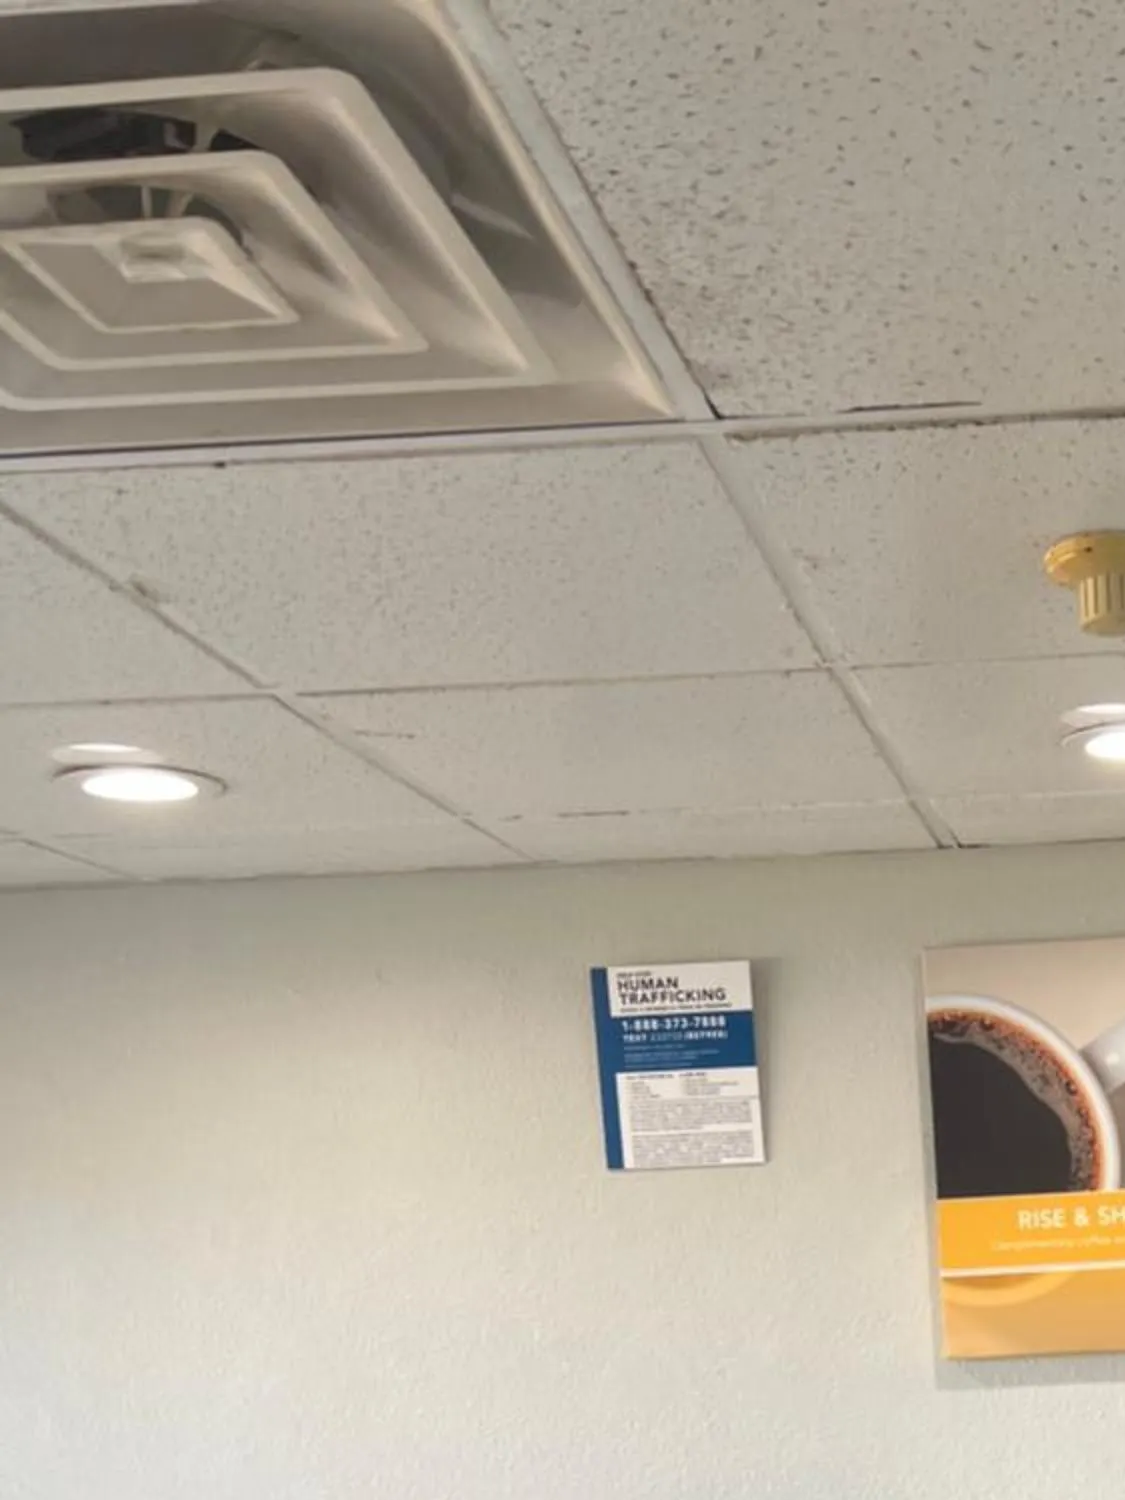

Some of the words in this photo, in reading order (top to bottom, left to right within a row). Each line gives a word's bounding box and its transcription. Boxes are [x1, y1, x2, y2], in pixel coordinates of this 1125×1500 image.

[617, 976, 679, 991] HUMAN
[619, 987, 726, 1005] TRAFFICKING
[1017, 1208, 1066, 1230] RISE
[1073, 1206, 1090, 1228] &
